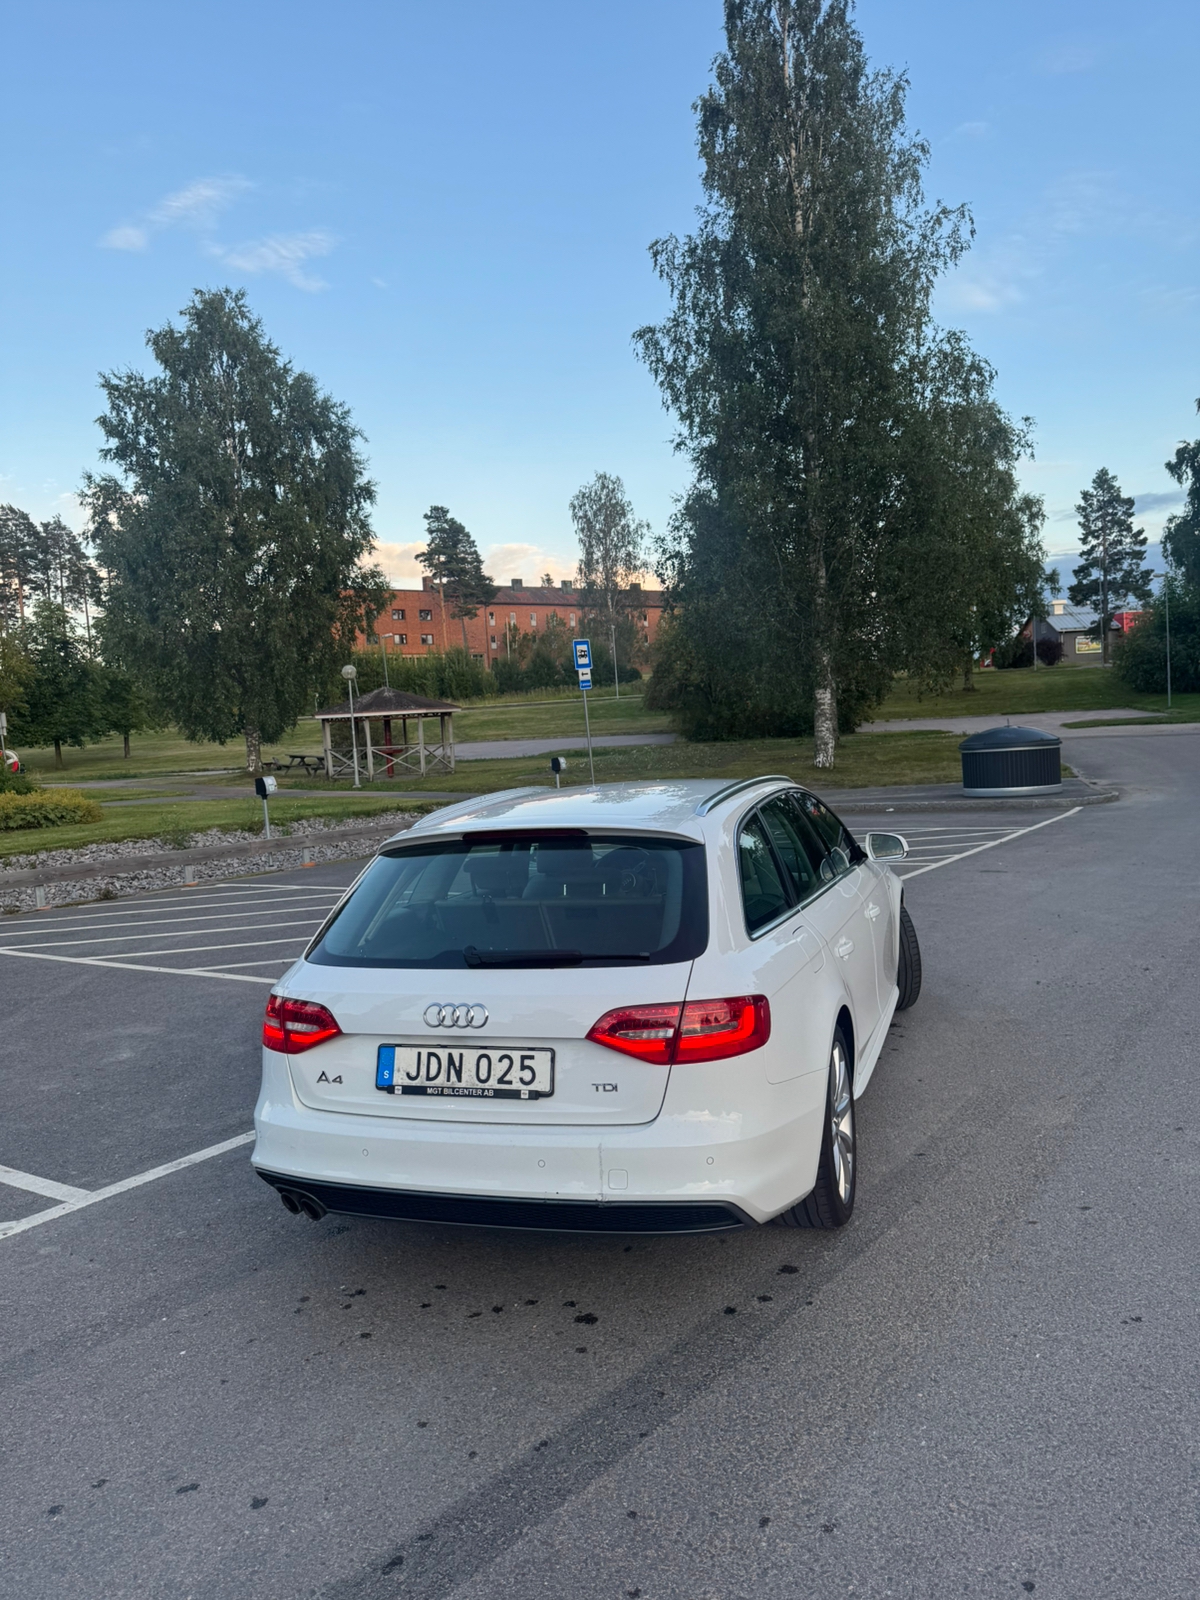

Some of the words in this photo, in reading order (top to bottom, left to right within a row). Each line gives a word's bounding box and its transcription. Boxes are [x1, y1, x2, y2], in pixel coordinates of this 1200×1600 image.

[405, 1051, 464, 1083] JDN
[475, 1053, 537, 1086] 025
[316, 1070, 344, 1085] A4
[383, 1070, 390, 1080] S
[426, 1087, 443, 1096] MGT
[443, 1088, 482, 1097] BILCENTER
[483, 1089, 495, 1097] AB
[591, 1082, 619, 1093] TDI
